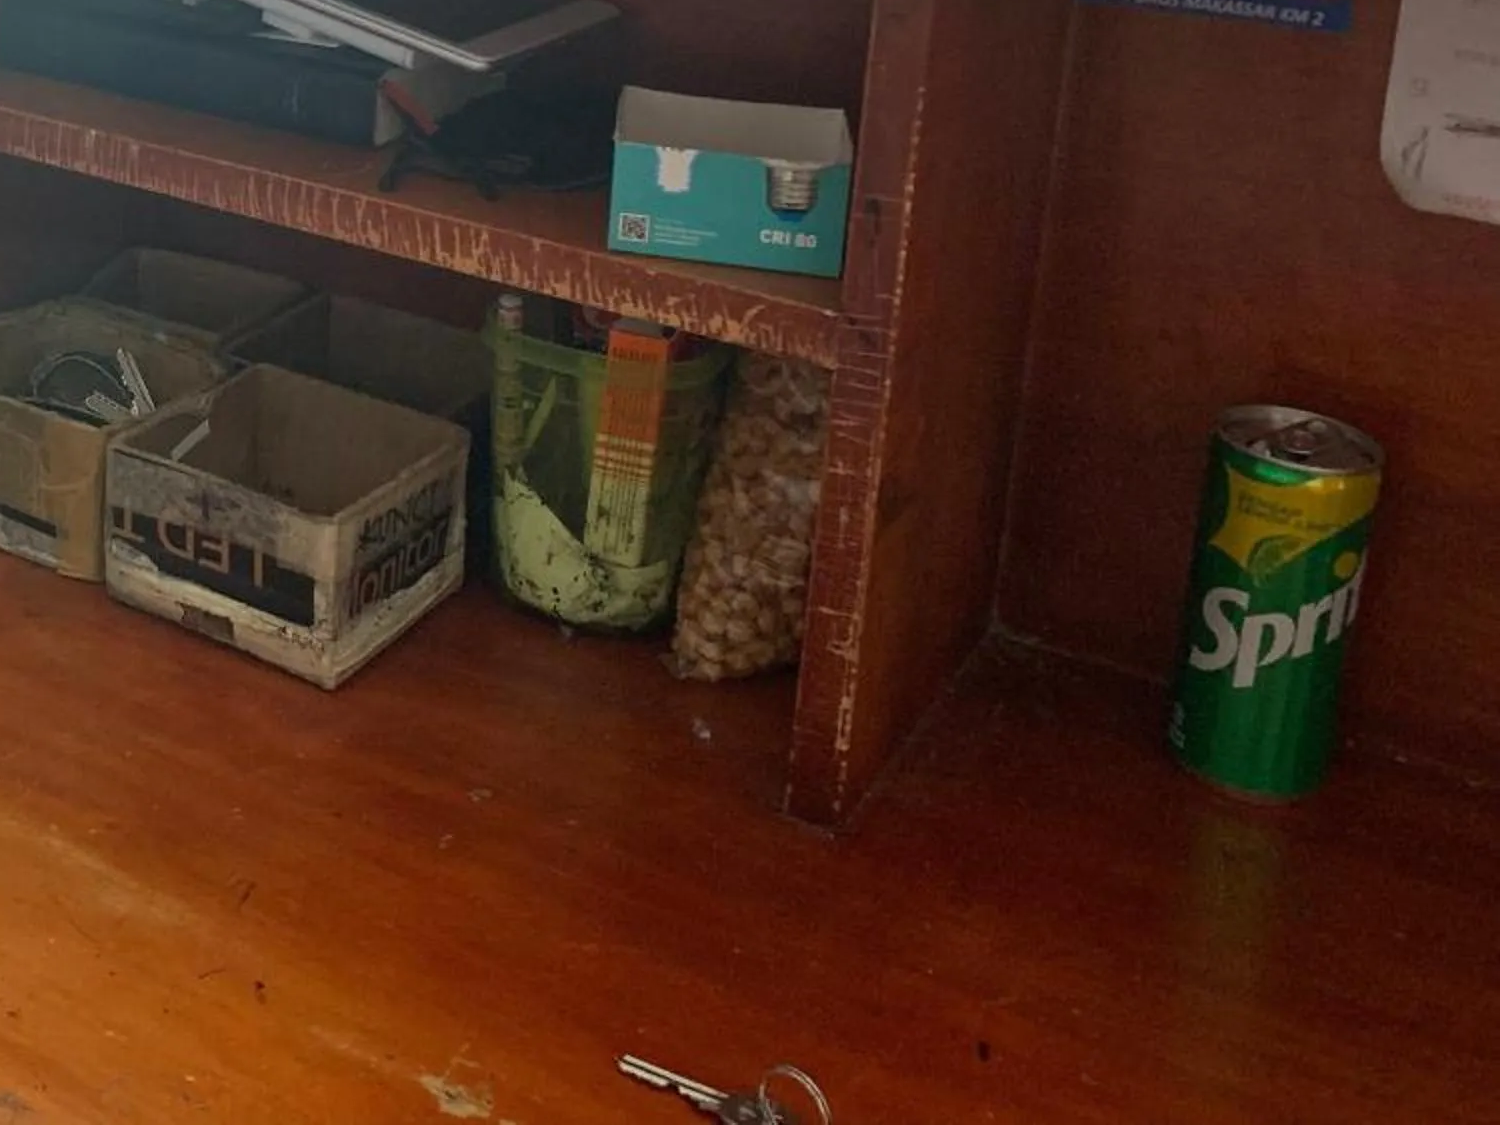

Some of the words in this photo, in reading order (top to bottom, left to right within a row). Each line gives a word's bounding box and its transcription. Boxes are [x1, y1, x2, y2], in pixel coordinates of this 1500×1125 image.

[1278, 8, 1310, 26] KM
[1311, 10, 1327, 27] 2
[759, 228, 792, 245] CRI
